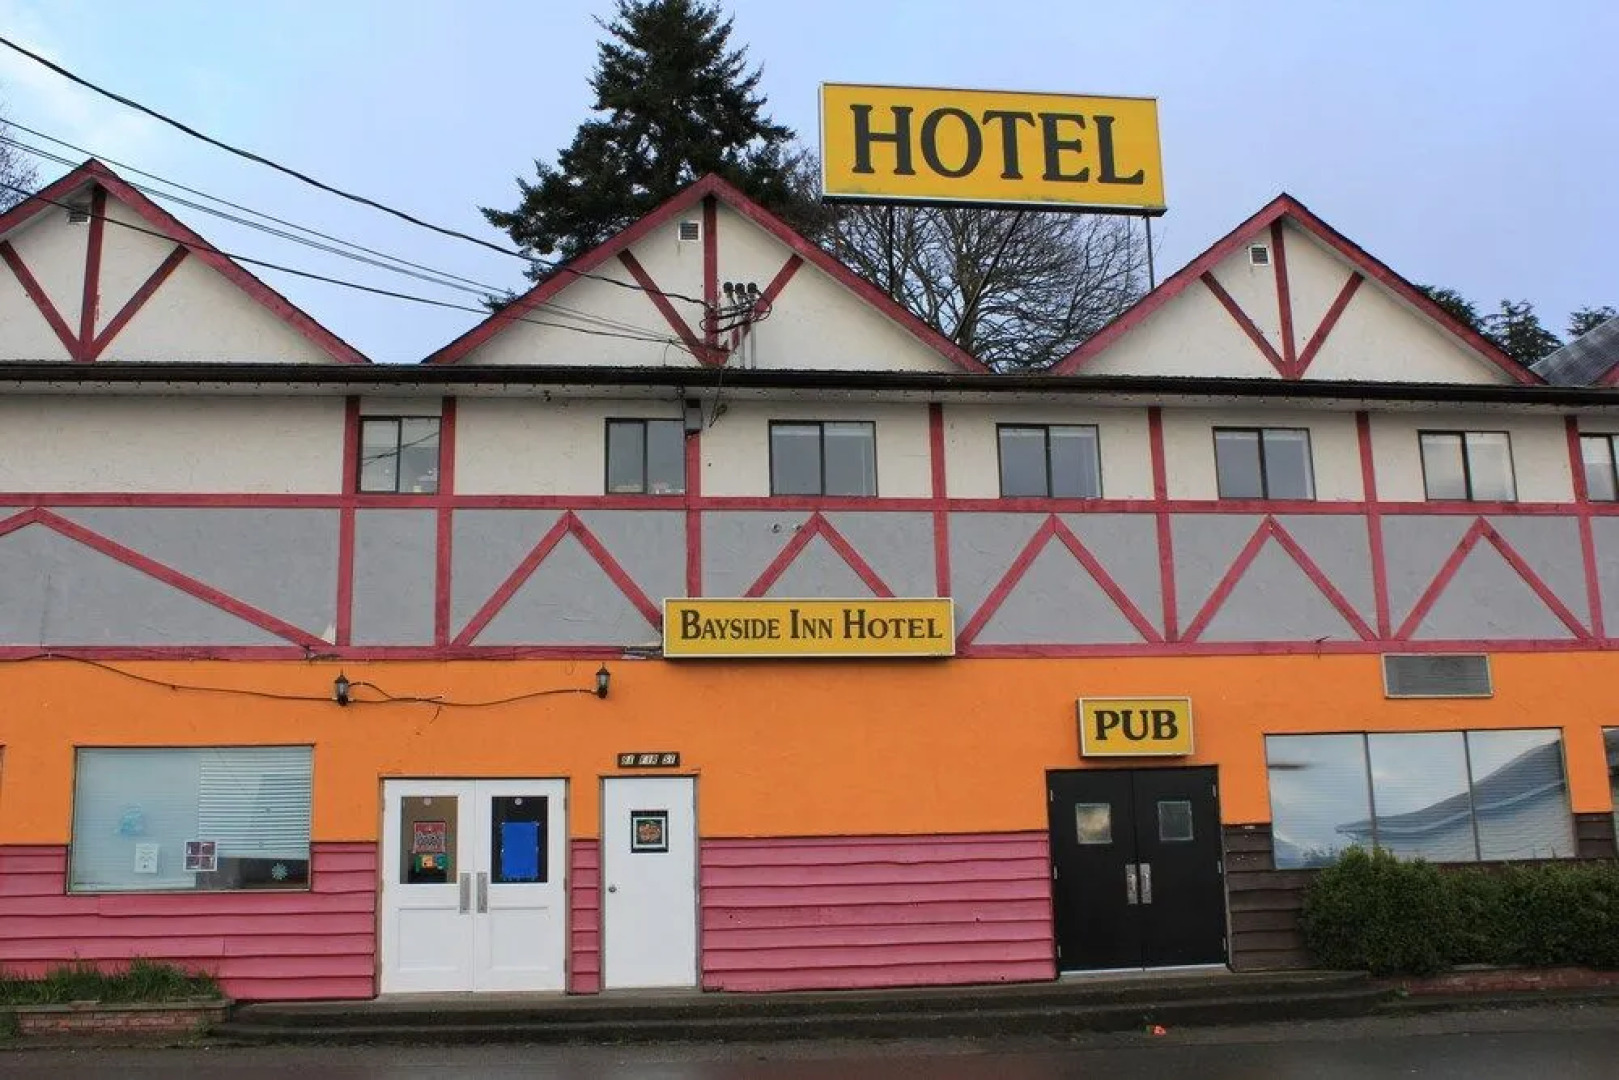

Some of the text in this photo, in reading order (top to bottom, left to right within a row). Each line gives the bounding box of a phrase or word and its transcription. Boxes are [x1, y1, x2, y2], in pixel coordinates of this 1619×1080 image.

[850, 104, 1145, 185] HOTEL
[680, 608, 943, 640] BAYSIDE INN HOTEL
[1093, 709, 1178, 741] PUB
